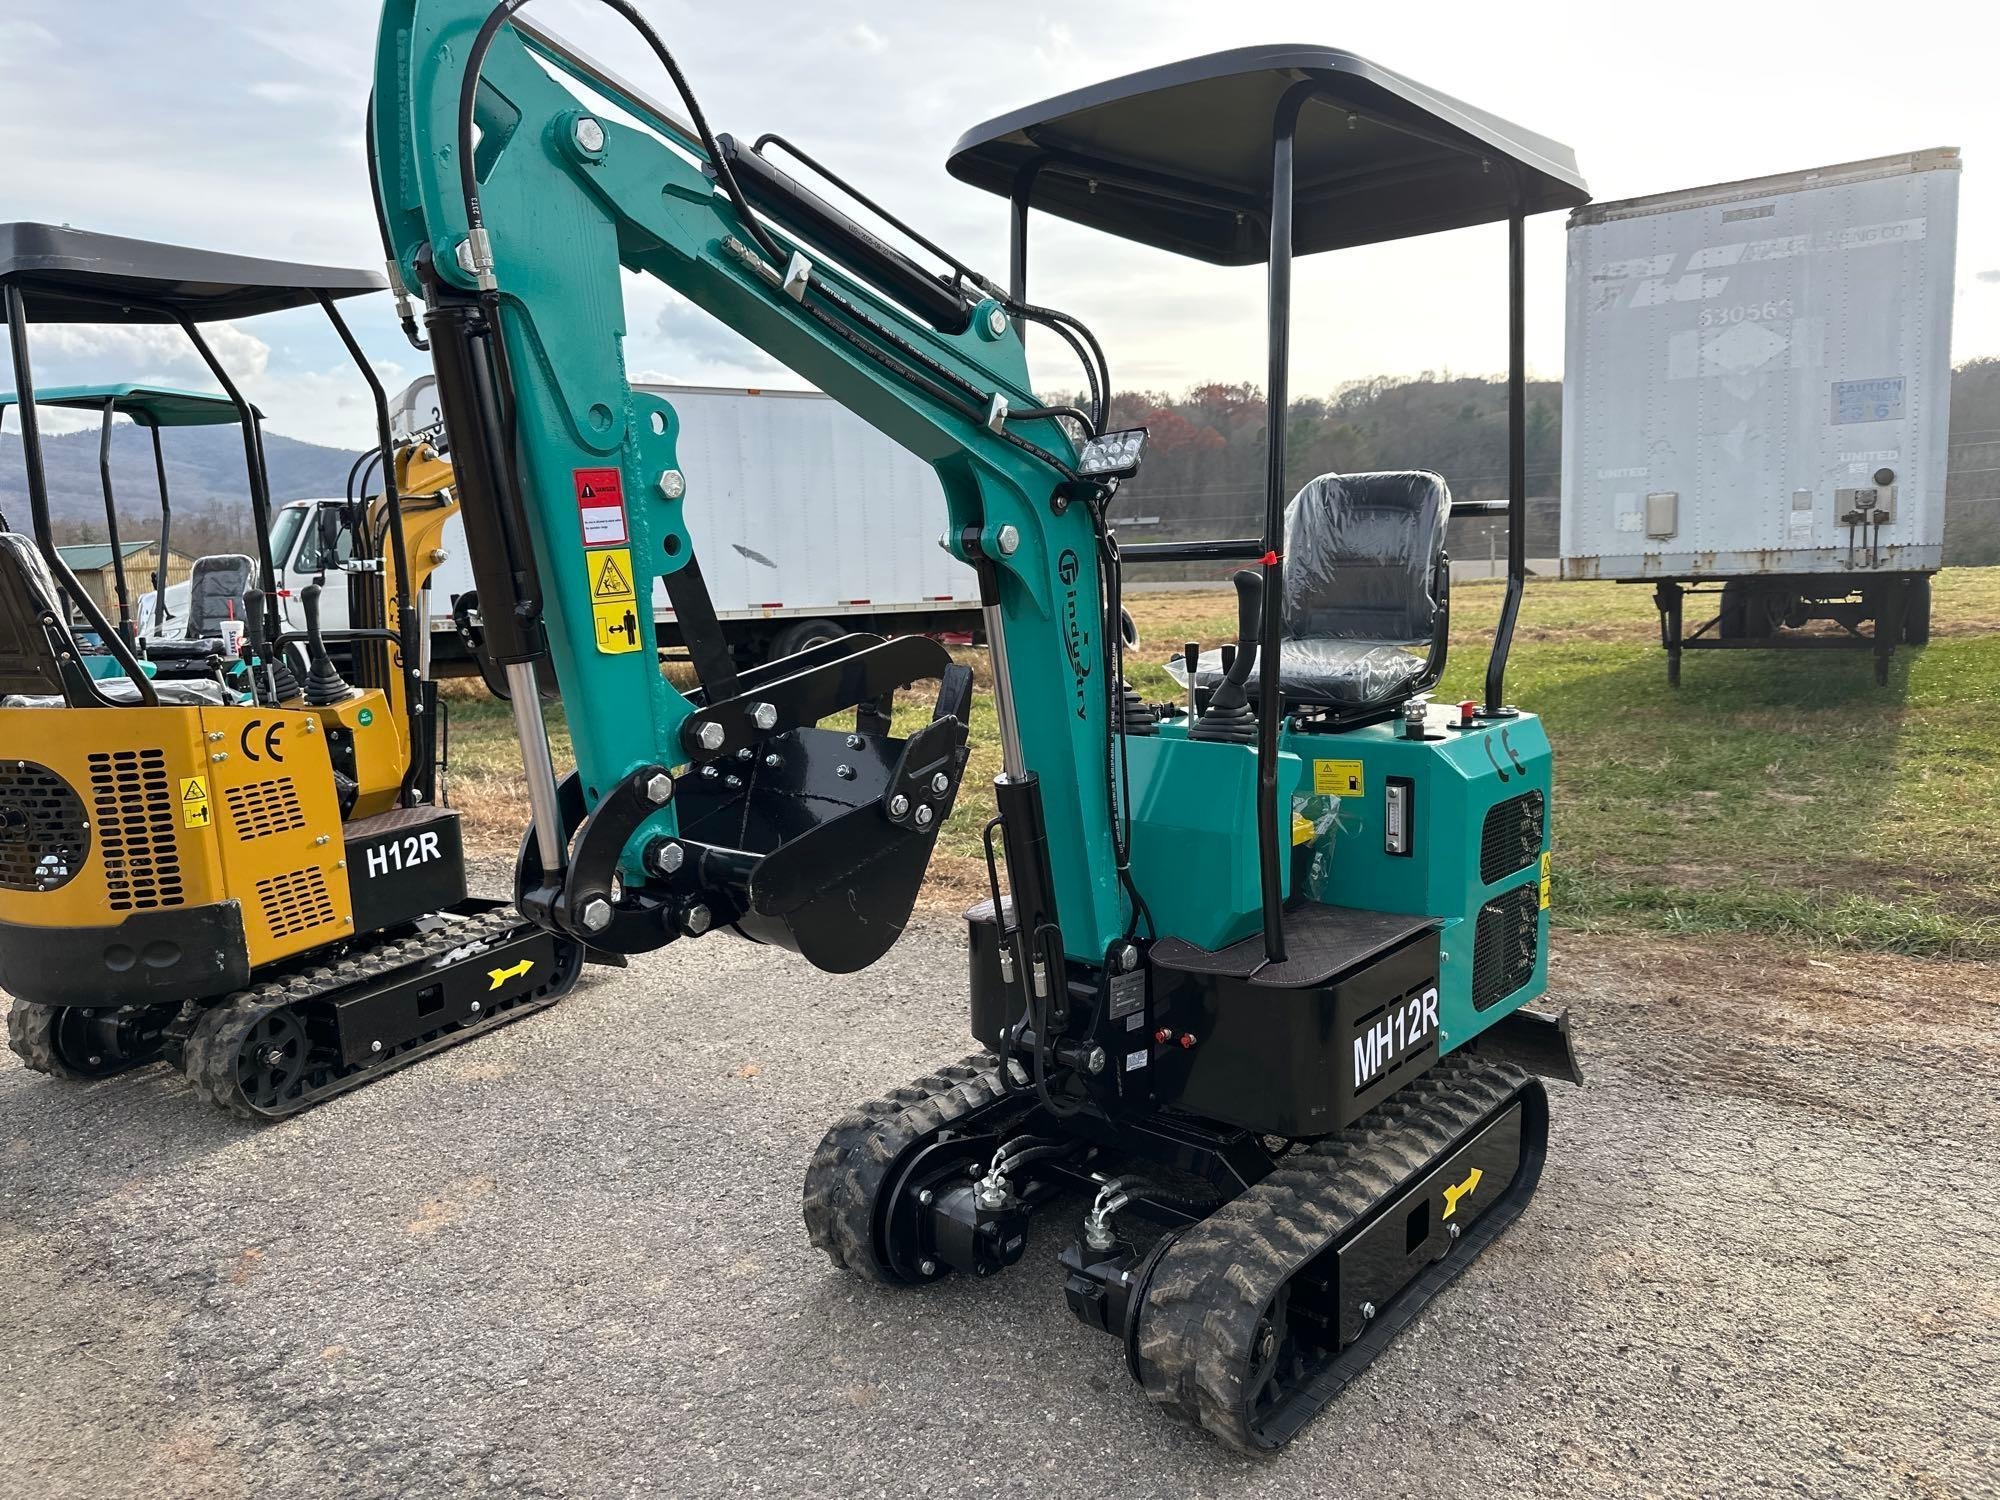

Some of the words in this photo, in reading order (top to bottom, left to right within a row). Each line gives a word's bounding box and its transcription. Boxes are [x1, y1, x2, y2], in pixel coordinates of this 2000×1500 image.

[1837, 380, 1902, 394] CAUTION
[1840, 450, 1898, 462] UNITED
[1598, 467, 1648, 480] UNITED
[241, 719, 285, 762] CE
[366, 831, 442, 879] H12R
[1353, 987, 1440, 1087] MH12R
